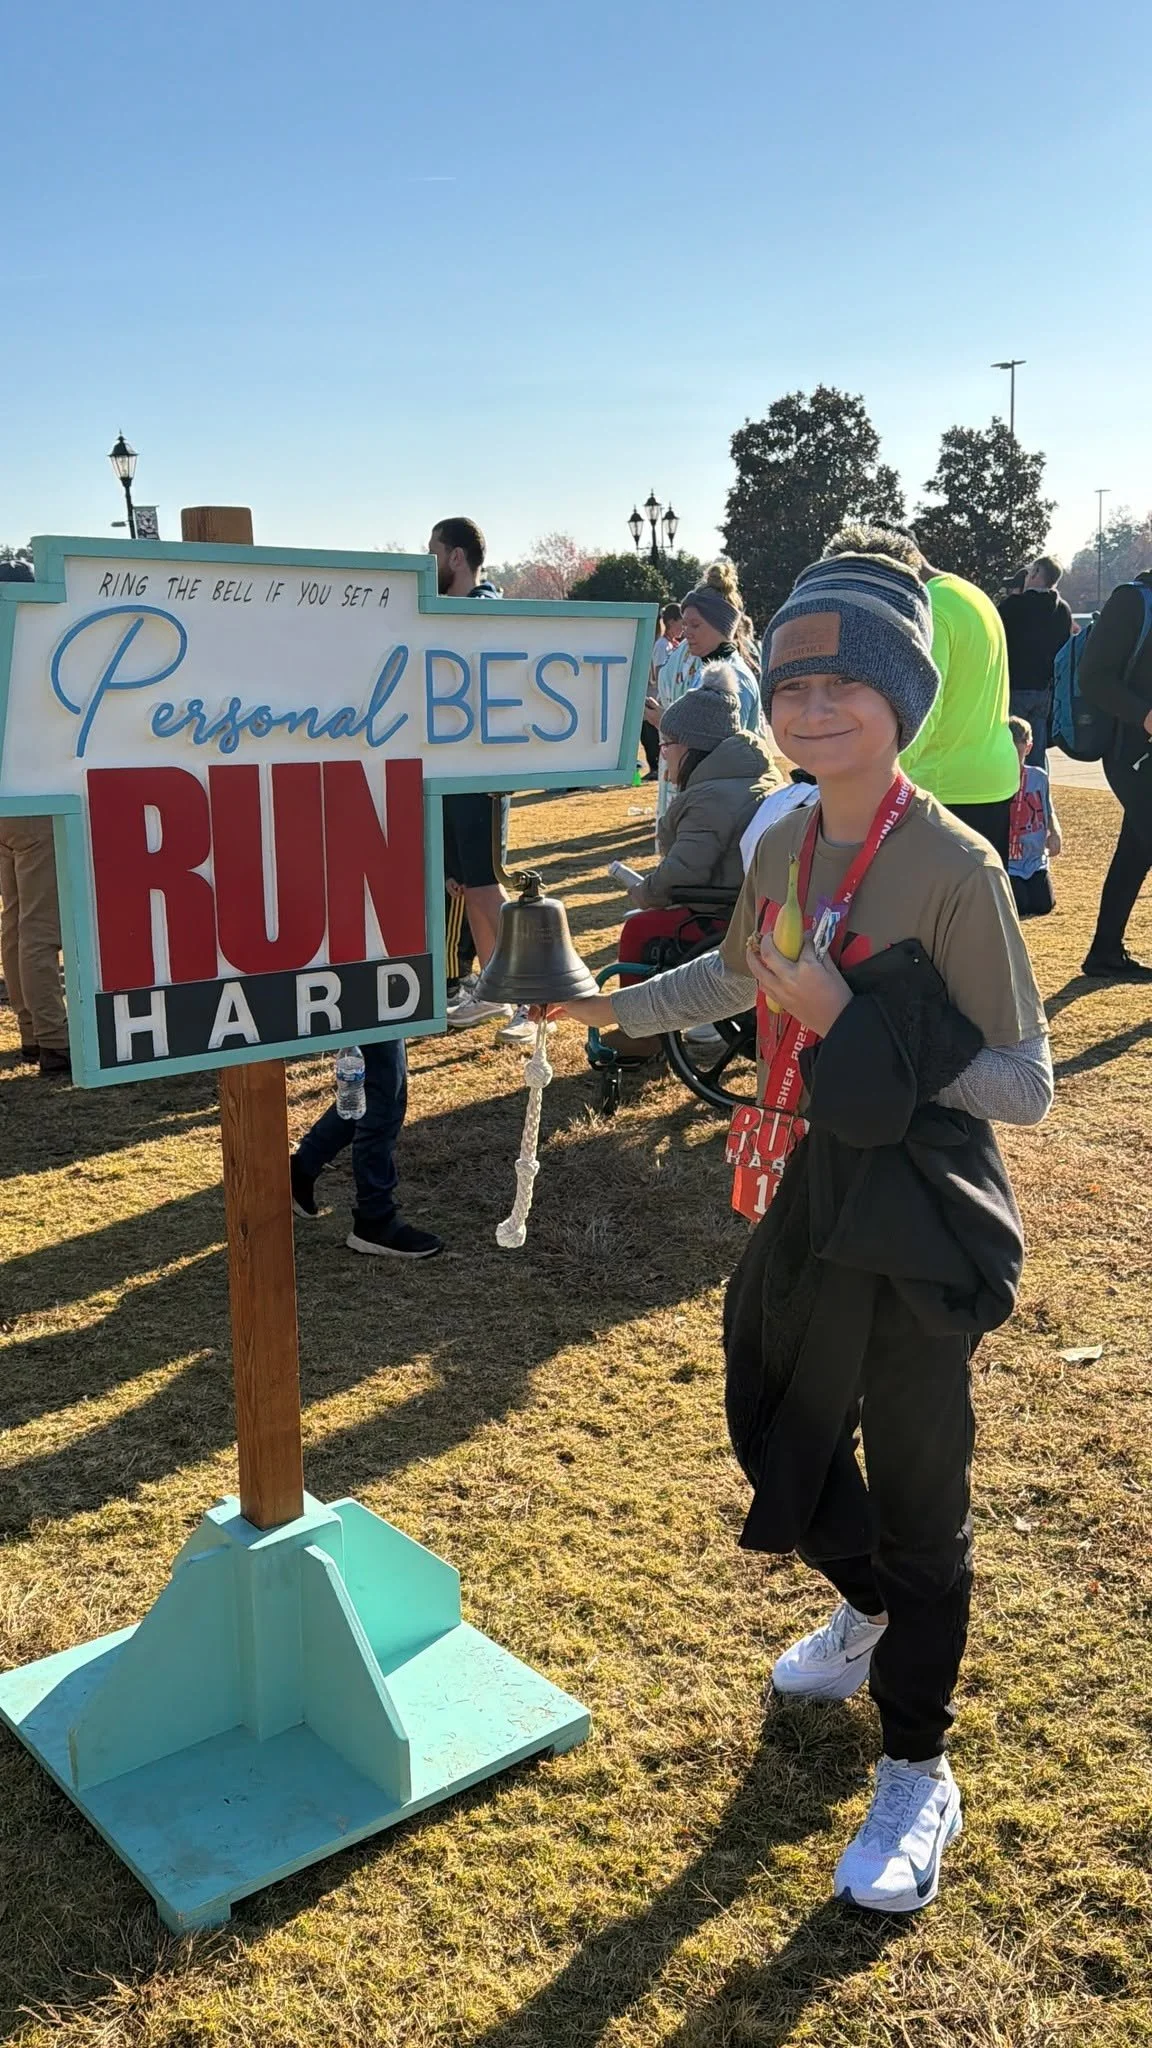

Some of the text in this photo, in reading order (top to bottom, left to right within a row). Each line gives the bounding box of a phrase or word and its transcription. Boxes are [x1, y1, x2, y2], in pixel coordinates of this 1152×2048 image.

[99, 572, 391, 608] RING THE BELL IF YOU SET A
[51, 604, 628, 757] Personal BEST
[895, 782, 910, 805] ARD
[87, 758, 426, 992] RUN
[113, 962, 421, 1062] HARD
[727, 1104, 808, 1161] RU
[726, 1149, 786, 1179] HAR
